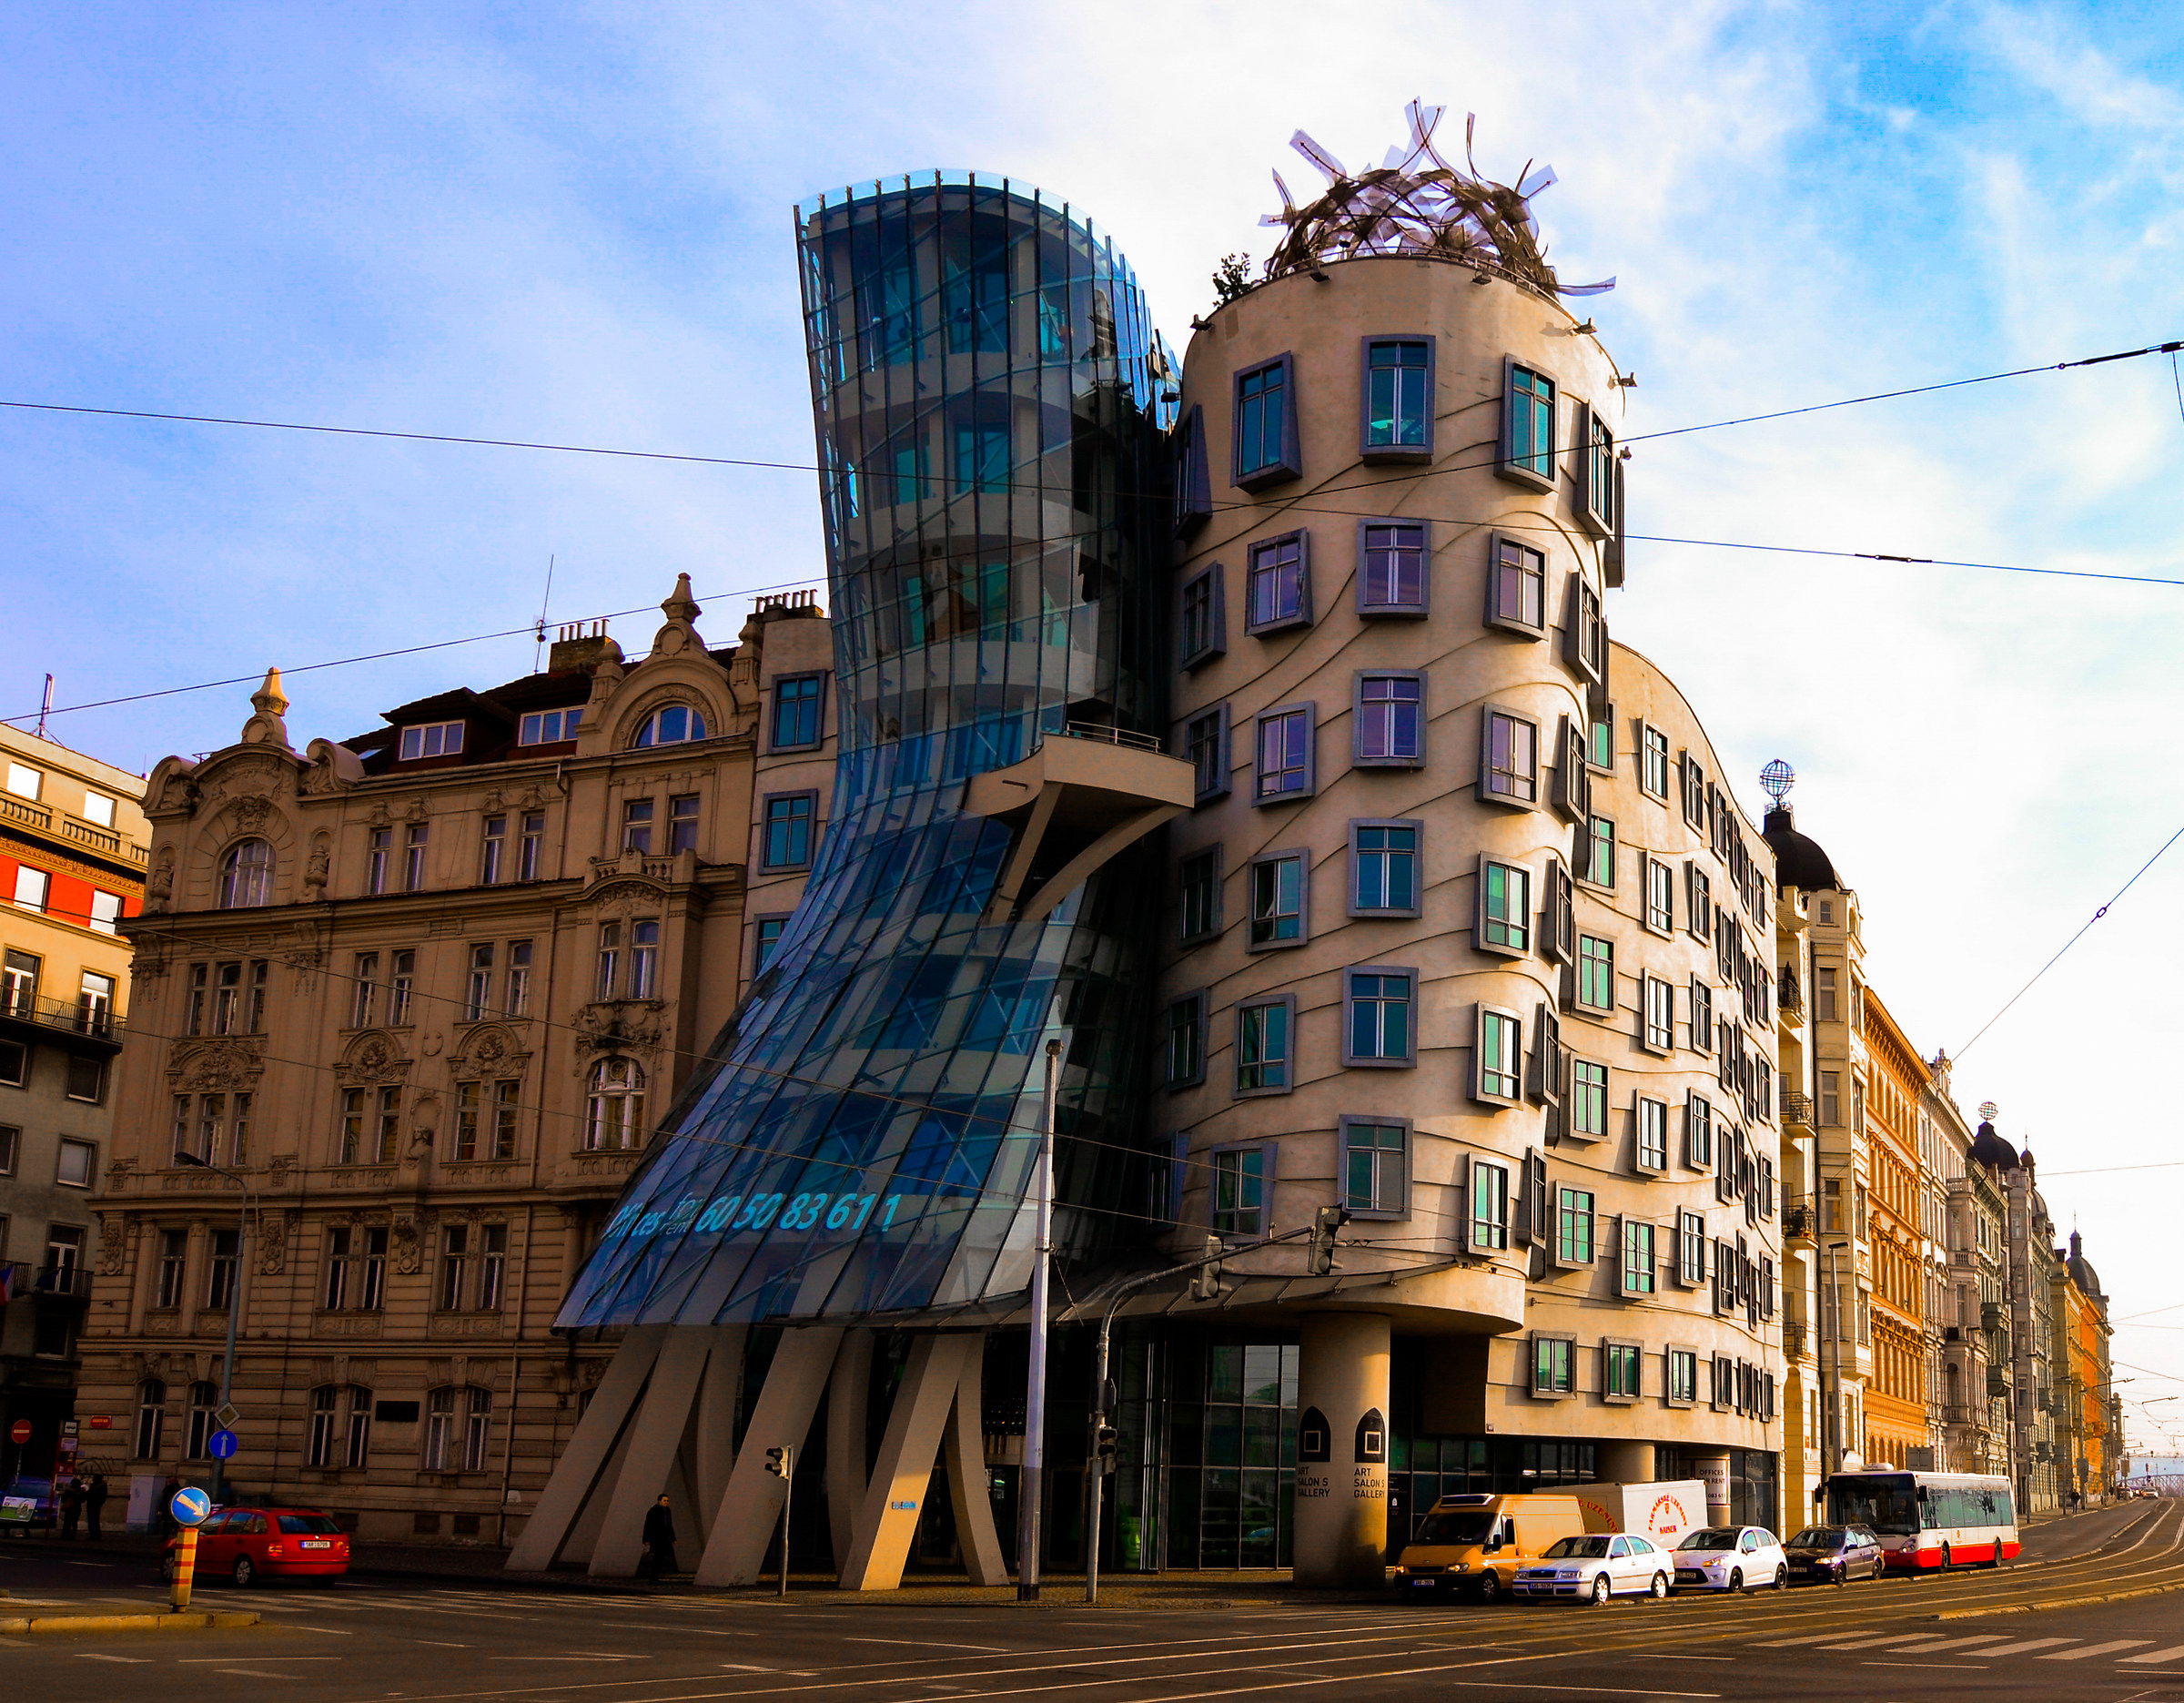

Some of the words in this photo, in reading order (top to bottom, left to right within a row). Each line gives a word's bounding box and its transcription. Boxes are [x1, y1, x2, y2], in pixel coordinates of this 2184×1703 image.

[601, 1202, 667, 1239] Offces
[1353, 1467, 1371, 1476] ART
[1353, 1478, 1380, 1487] SALON
